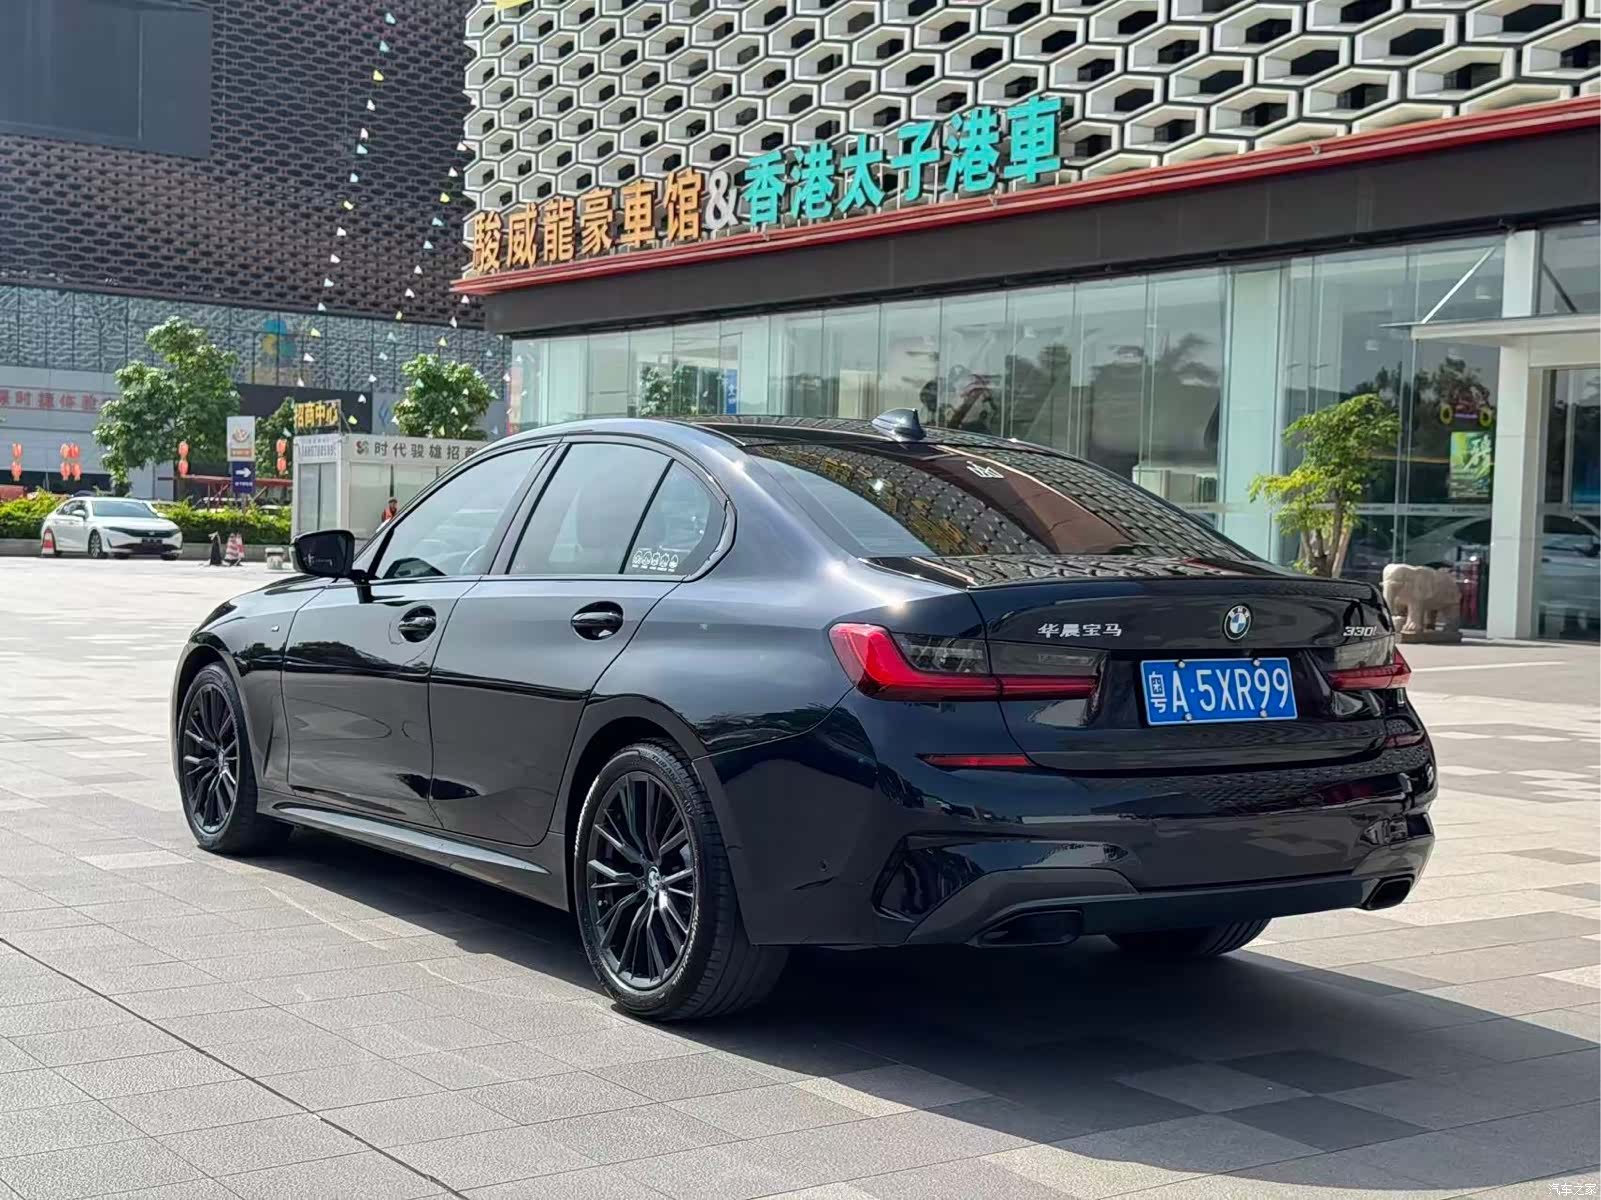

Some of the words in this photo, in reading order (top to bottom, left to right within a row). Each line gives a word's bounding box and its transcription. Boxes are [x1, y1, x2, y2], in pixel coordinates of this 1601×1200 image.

[294, 401, 338, 428] 招商中心
[1037, 623, 1122, 638] 华晨宝马
